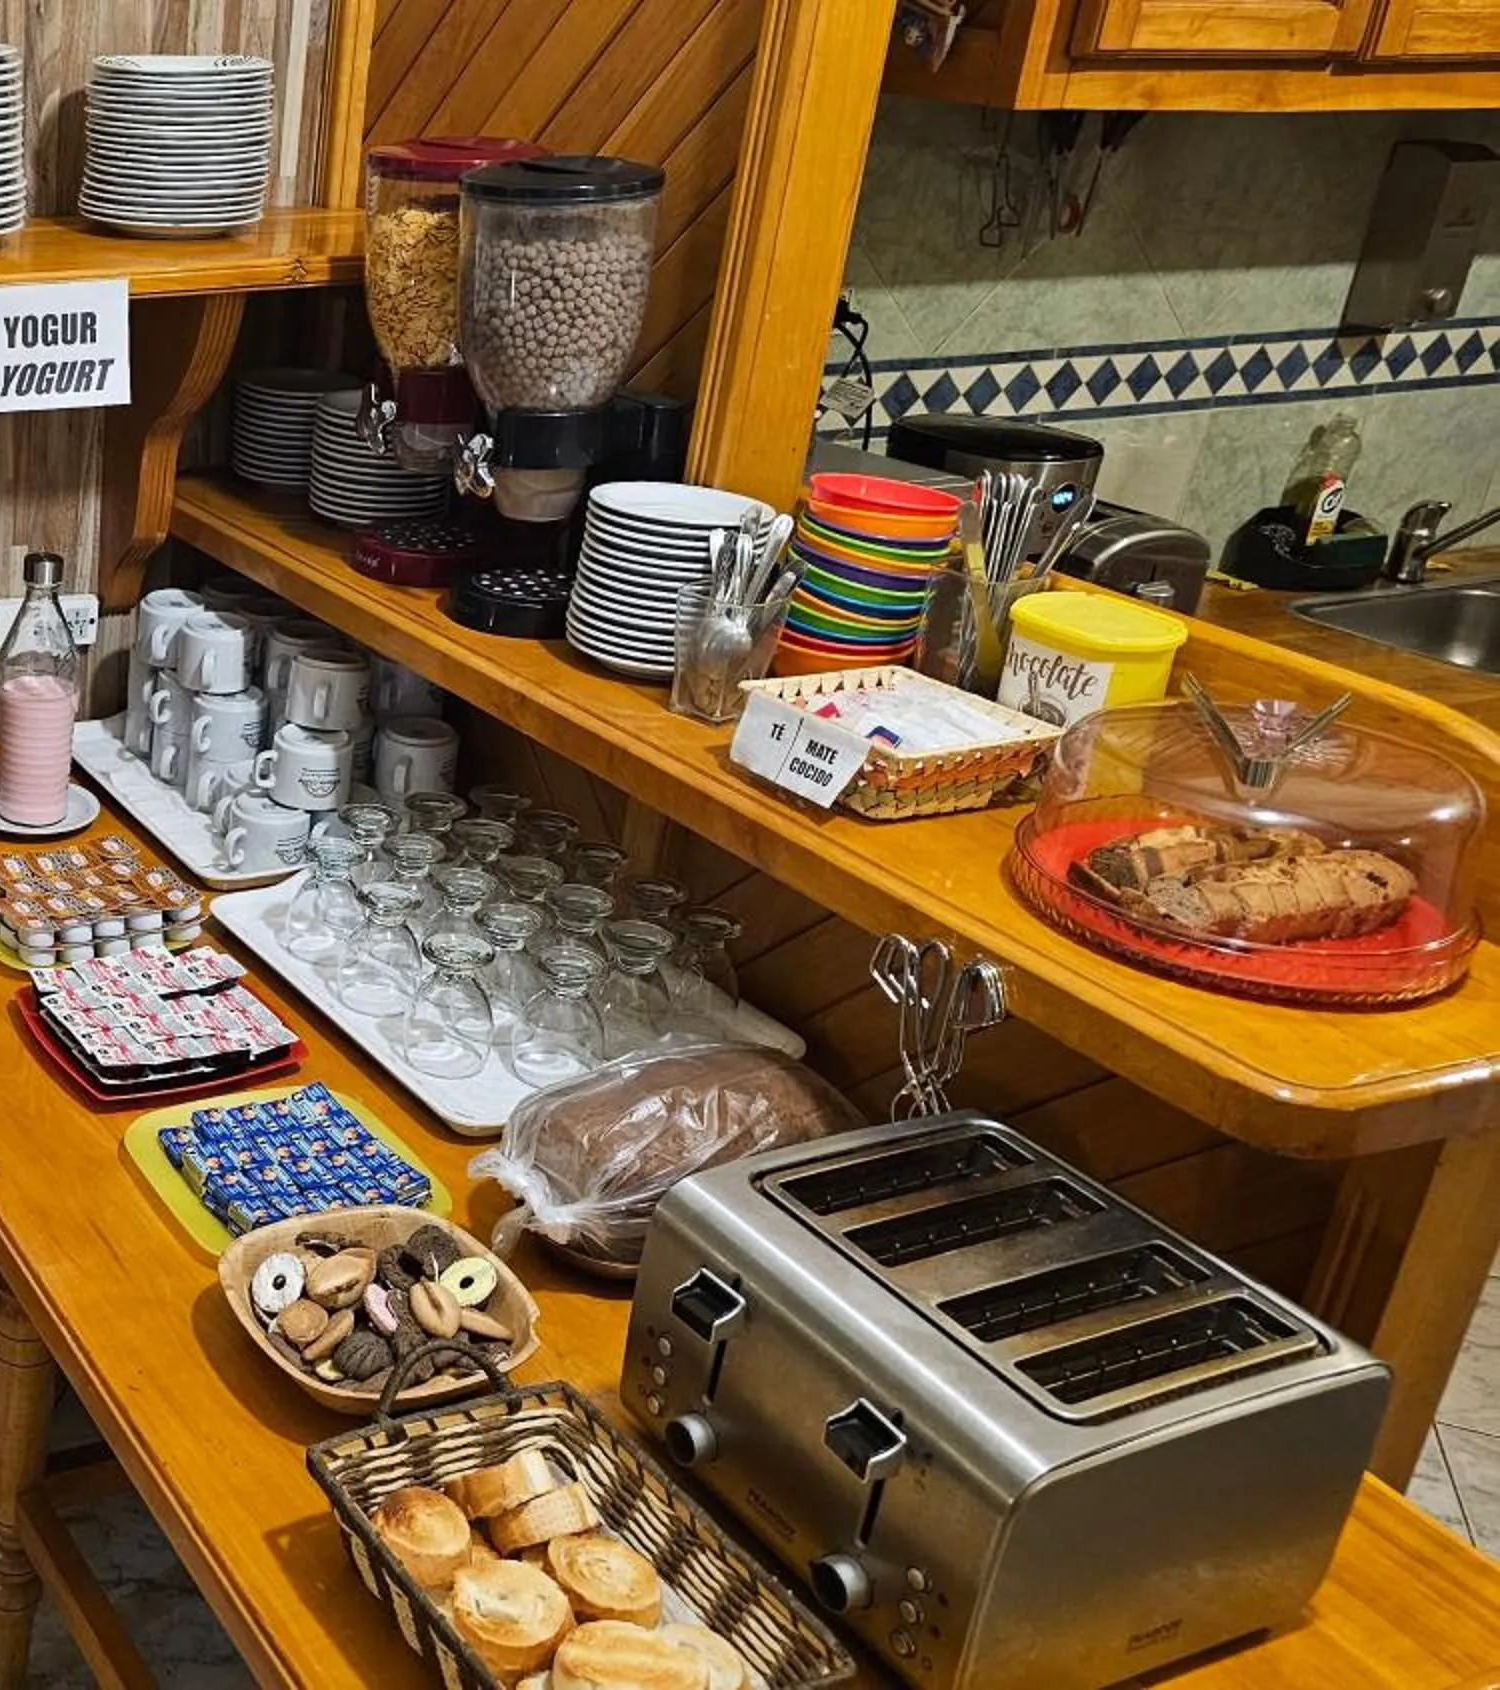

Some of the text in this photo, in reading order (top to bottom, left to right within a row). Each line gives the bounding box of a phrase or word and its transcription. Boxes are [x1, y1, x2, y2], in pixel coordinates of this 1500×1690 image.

[3, 311, 98, 349] YOGUR
[0, 358, 115, 397] YOGURT
[1008, 641, 1098, 701] hocolate
[770, 722, 787, 741] TÉ
[805, 739, 839, 765] MATE
[789, 757, 834, 788] COCIDO
